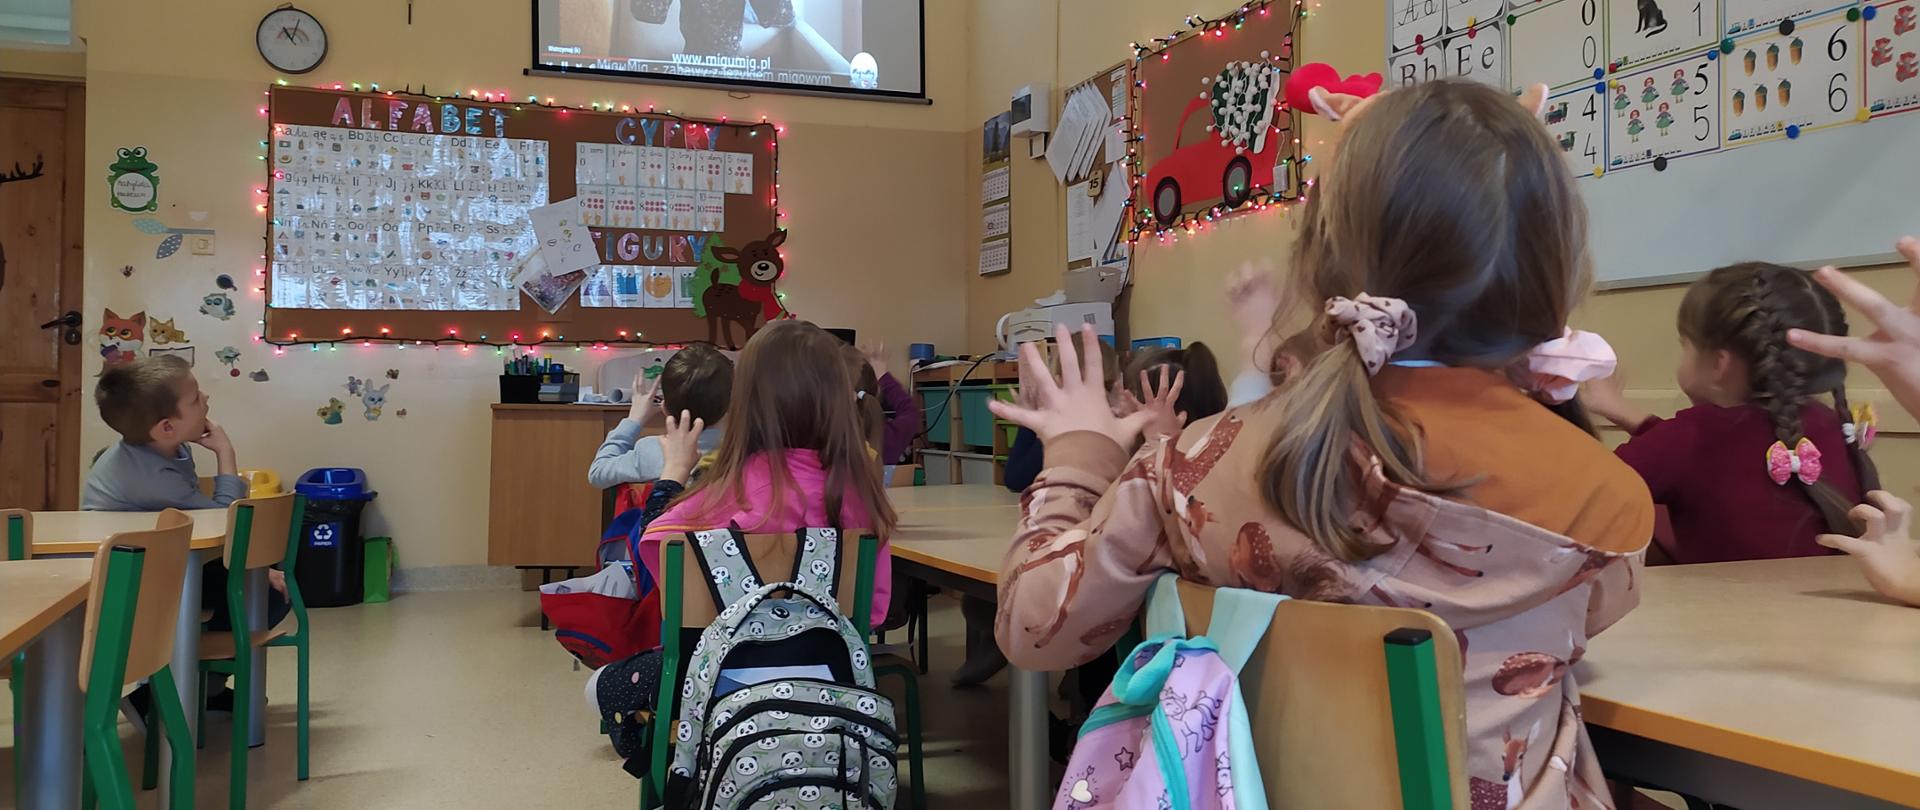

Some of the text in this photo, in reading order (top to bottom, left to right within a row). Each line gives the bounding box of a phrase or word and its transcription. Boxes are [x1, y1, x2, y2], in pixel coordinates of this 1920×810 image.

[1692, 2, 1702, 37] 1
[1583, 36, 1596, 69] 0
[1827, 25, 1848, 62] 6
[1693, 63, 1709, 96] 5
[1828, 72, 1848, 113] 6
[331, 97, 508, 137] ALFABET
[1582, 93, 1597, 122] 4
[1694, 104, 1710, 141] 5
[348, 130, 364, 140] Bb
[383, 133, 399, 142] Cc
[452, 138, 466, 147] Dd
[1584, 132, 1597, 165] 4
[312, 174, 328, 183] Hh
[386, 178, 396, 191] Jj
[418, 180, 432, 189] Kk
[1088, 177, 1099, 190] 15
[348, 221, 364, 231] Oo
[418, 223, 434, 234] Pp
[486, 225, 500, 234] Ss
[591, 231, 707, 263] IGURY
[384, 267, 400, 278] Yy
